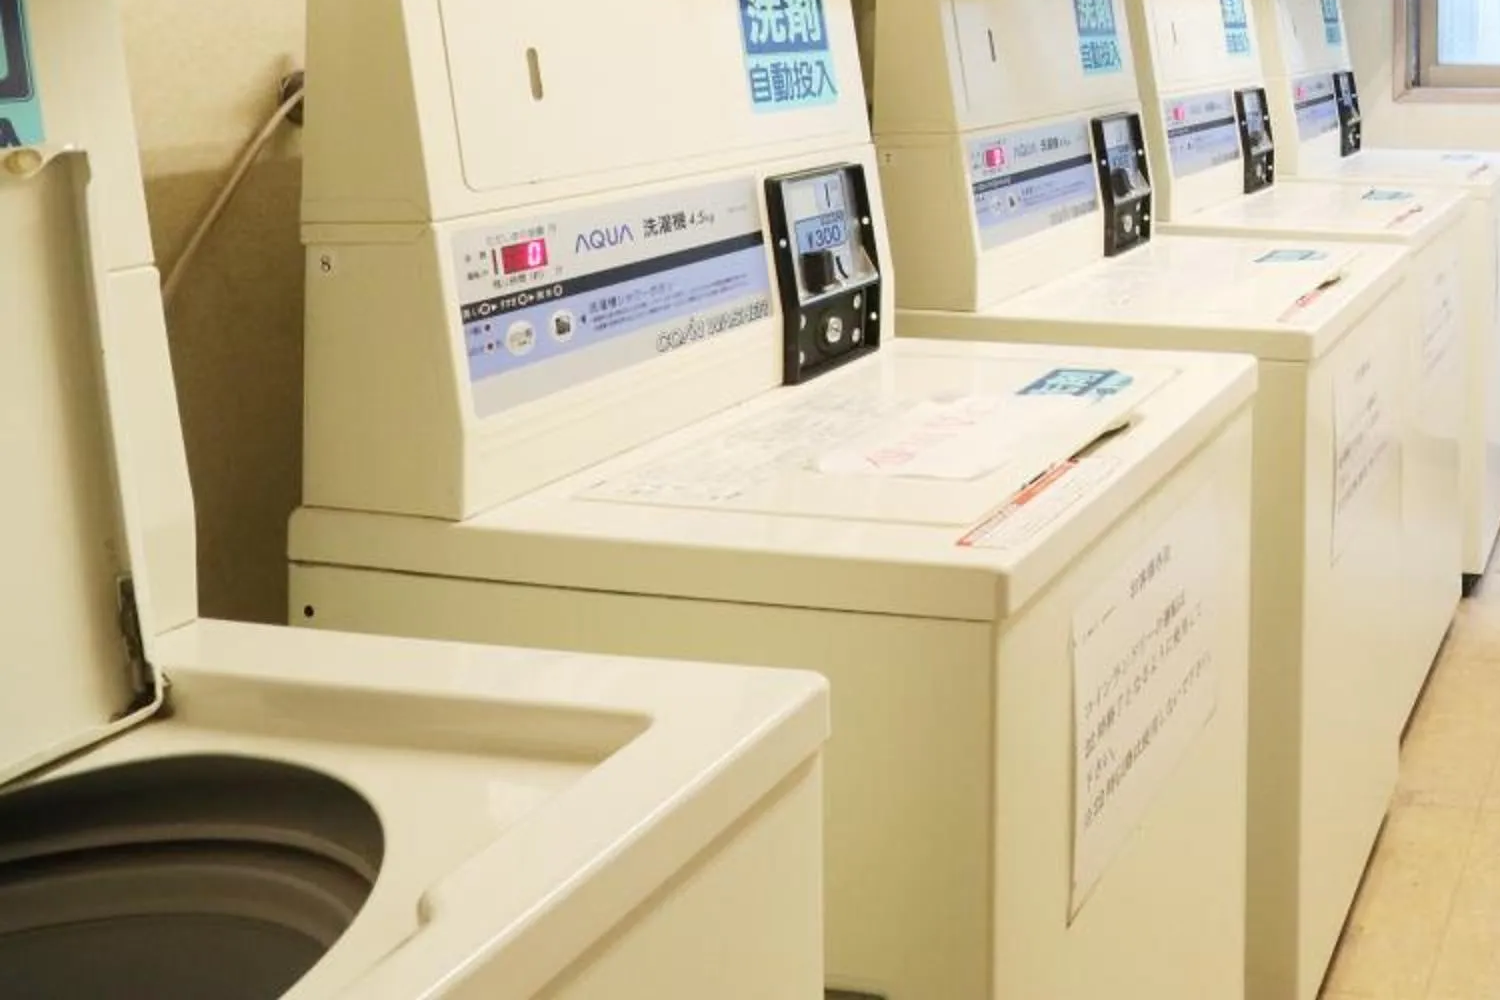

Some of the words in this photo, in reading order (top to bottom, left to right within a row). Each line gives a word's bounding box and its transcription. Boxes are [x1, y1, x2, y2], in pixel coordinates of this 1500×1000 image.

[750, 60, 838, 103] 自動投入
[575, 224, 634, 253] AQUA
[528, 241, 541, 266] 0
